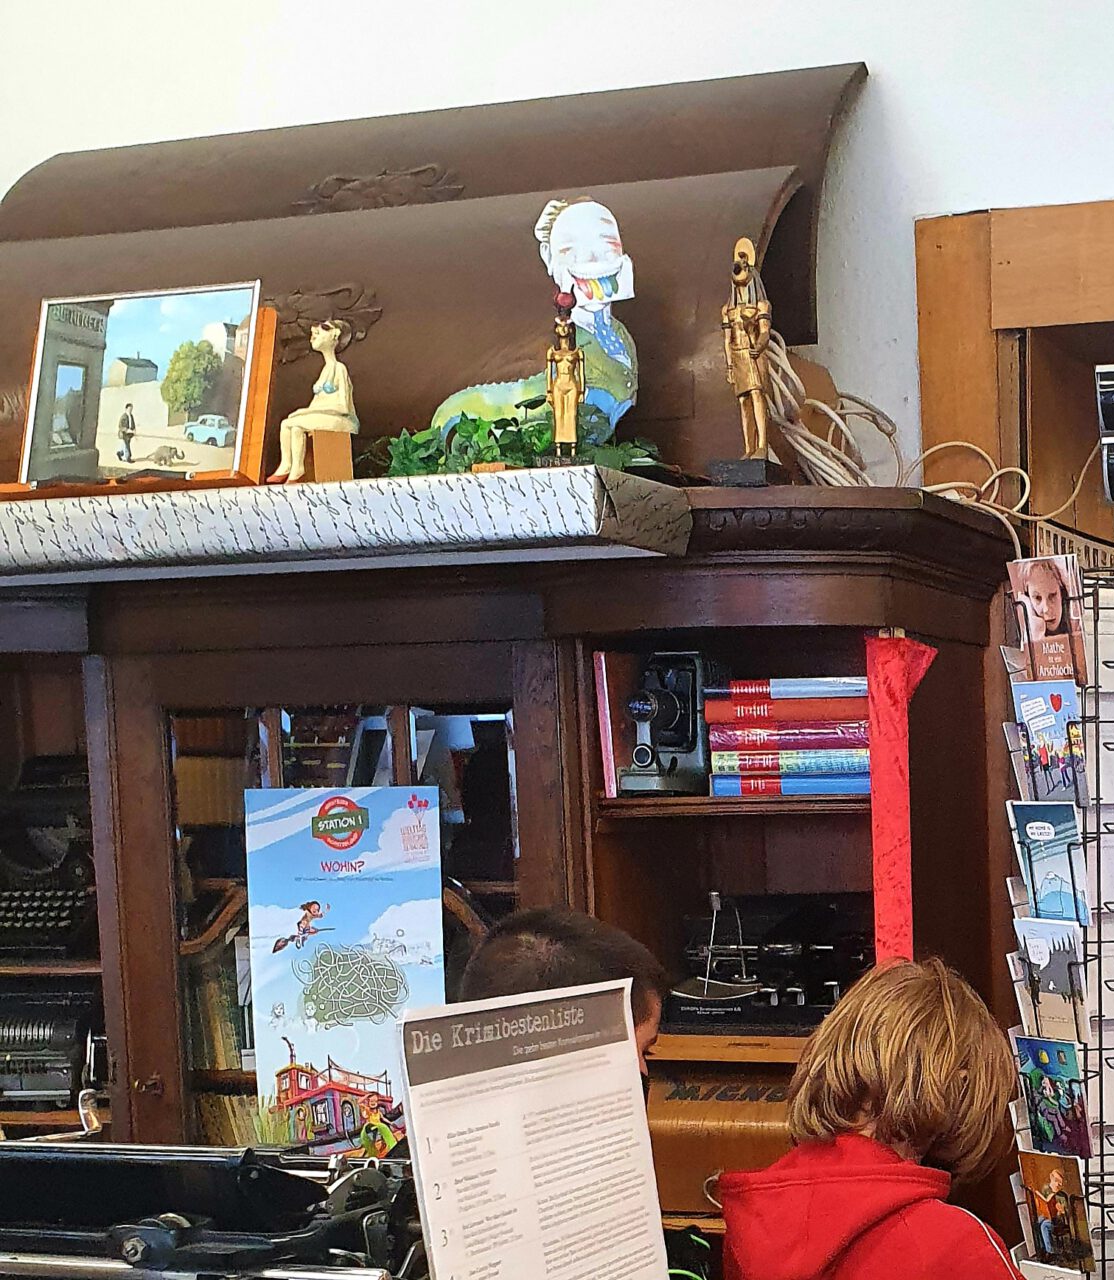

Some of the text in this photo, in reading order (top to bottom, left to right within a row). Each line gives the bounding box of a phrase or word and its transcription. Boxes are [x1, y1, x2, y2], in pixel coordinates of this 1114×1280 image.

[1042, 642, 1065, 655] Mathe
[1039, 664, 1074, 677] Arschloch!
[318, 816, 356, 831] STATION
[320, 860, 365, 873] WOHIN?
[412, 1006, 585, 1055] Die Krimibestenliste
[432, 1183, 442, 1200] 2
[441, 1229, 449, 1247] 3
